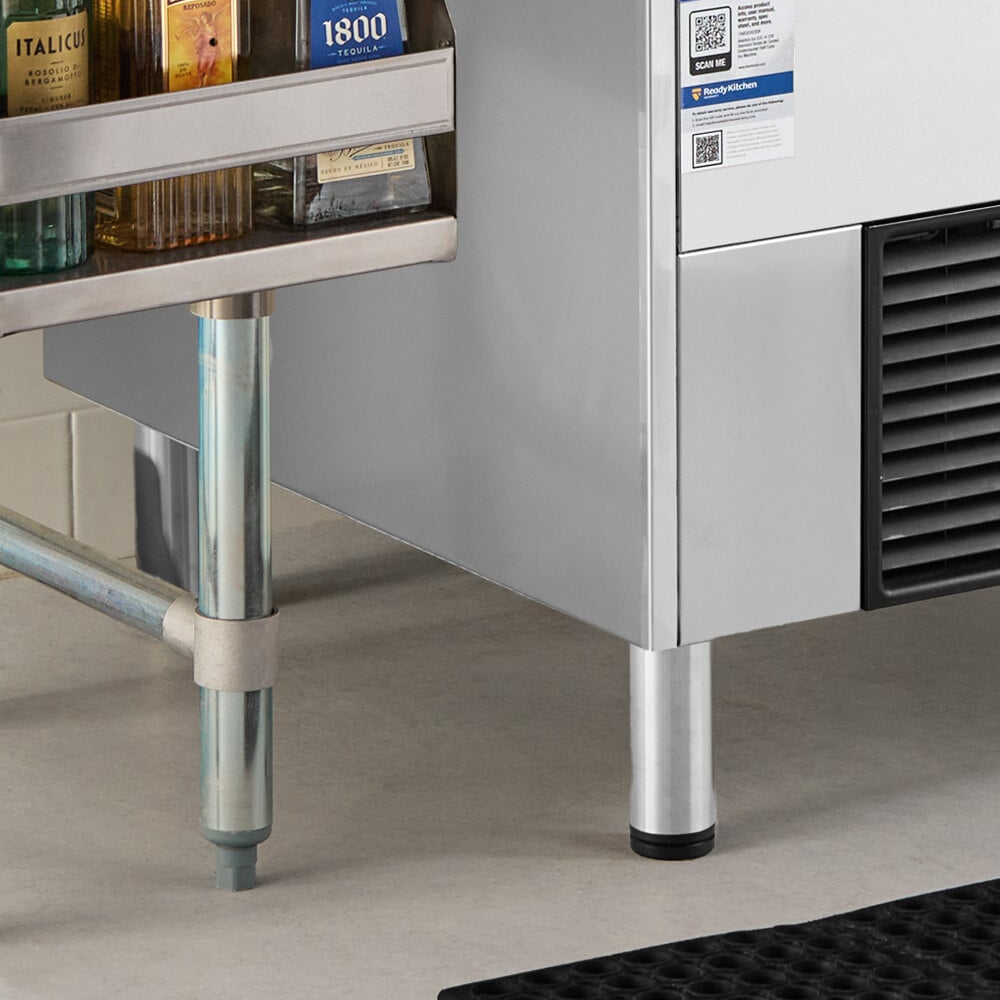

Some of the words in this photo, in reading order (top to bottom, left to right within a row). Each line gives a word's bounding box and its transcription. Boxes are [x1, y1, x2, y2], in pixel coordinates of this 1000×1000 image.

[183, 0, 217, 11] REPOSADO
[322, 12, 387, 47] 1800
[16, 28, 86, 56] ITALICUS
[337, 45, 378, 57] TEQUILA
[28, 65, 70, 77] ROSOLIO
[695, 59, 713, 71] SCAN
[715, 57, 727, 68] ME
[25, 71, 82, 86] BERGAMOTTO
